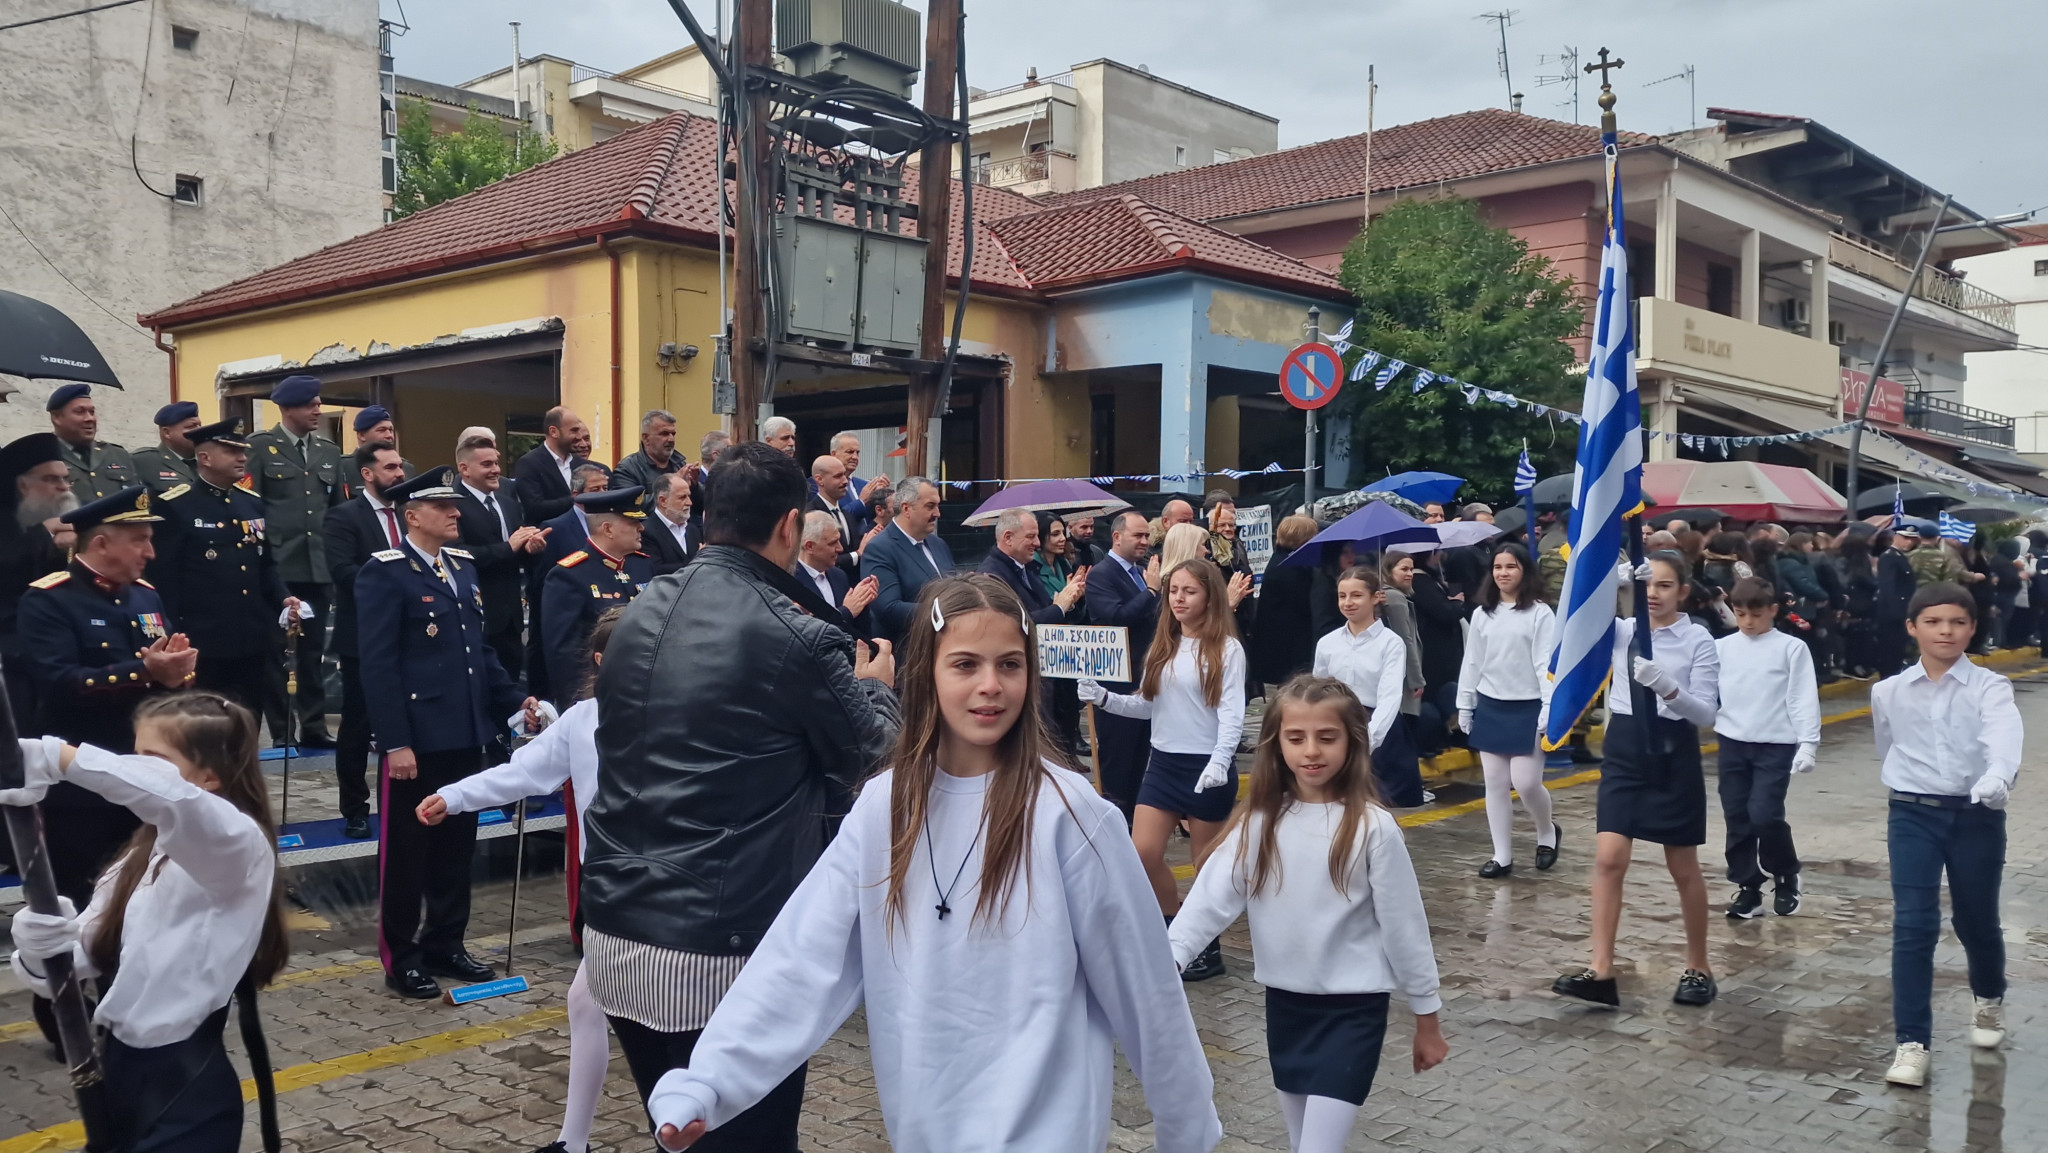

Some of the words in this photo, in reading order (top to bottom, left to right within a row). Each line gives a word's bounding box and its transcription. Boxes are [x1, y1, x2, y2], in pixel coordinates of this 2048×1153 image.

[49, 356, 91, 369] DUNLOP
[1842, 371, 1886, 409] ΣΥΡΖΑ
[1240, 522, 1269, 538] ΕΧΝΙΚΟ
[1070, 629, 1117, 644] ΣΧΟΛΕΙΟ
